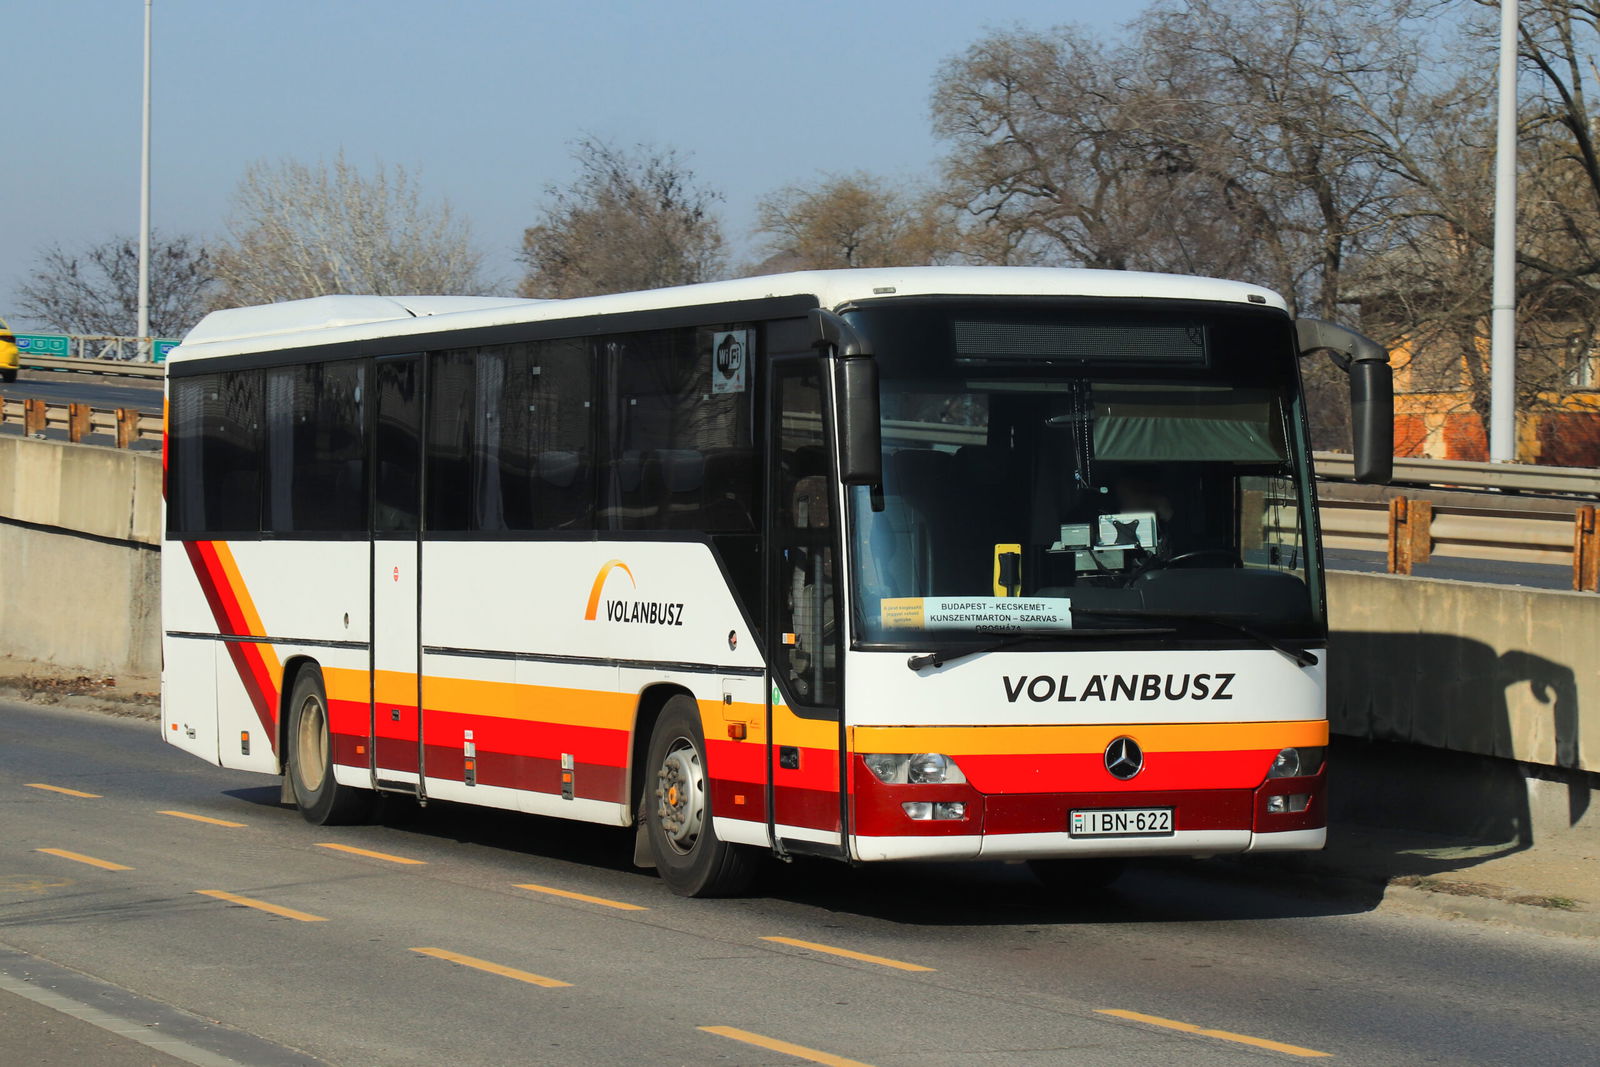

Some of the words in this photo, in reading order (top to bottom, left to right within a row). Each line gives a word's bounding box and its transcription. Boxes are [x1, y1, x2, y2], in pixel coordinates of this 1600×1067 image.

[607, 600, 684, 626] VOLÁNBUSZ
[941, 603, 987, 611] BUDAPEST
[996, 602, 1046, 611] KECSKEMÉT
[930, 613, 1011, 622] KUNSZENTMÁRTON
[1020, 614, 1057, 623] SZARVAS
[1002, 673, 1236, 703] VOLÁNBUSZ
[1092, 812, 1169, 832] IBN-622
